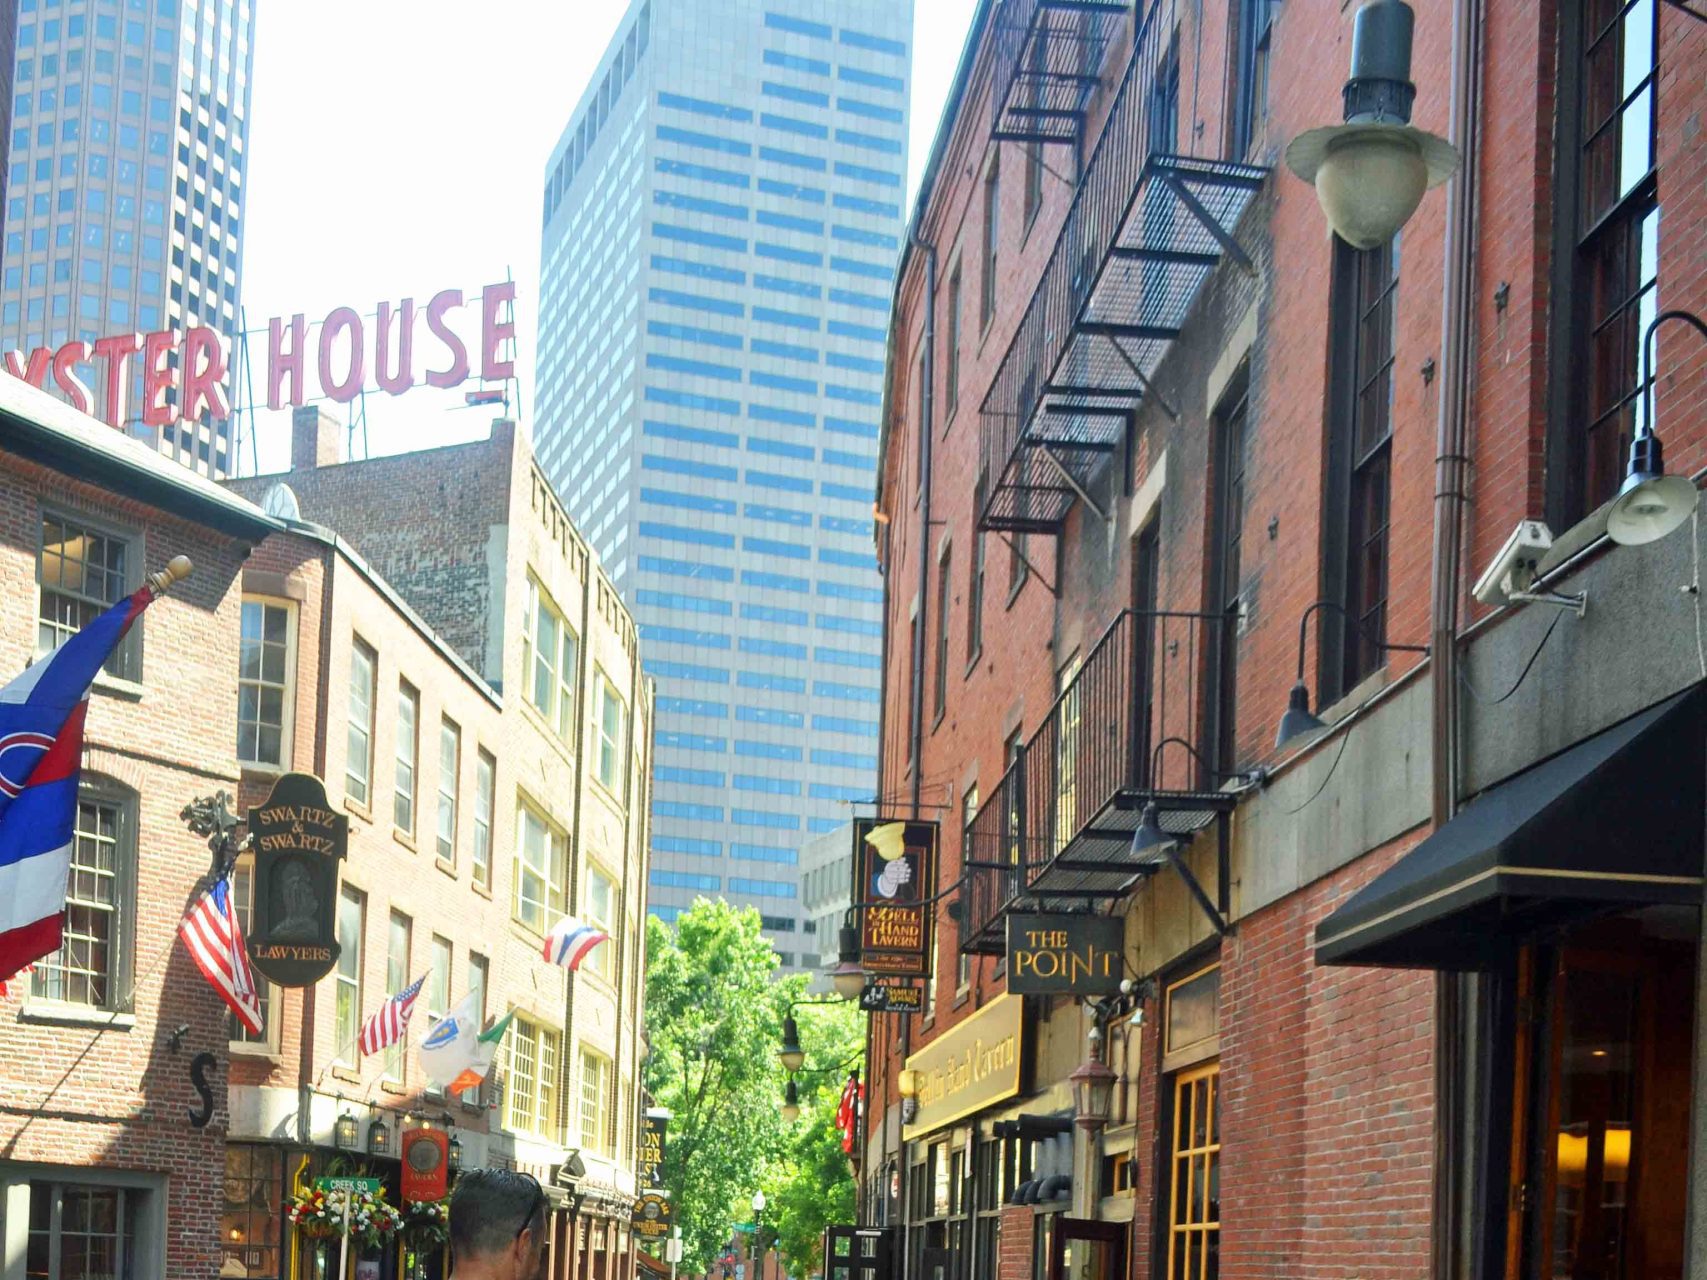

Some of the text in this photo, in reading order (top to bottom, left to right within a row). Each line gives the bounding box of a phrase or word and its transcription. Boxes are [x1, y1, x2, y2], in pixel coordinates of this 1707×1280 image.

[4, 281, 516, 427] YSTER HOUSE
[259, 806, 336, 829] SWARTZ
[291, 820, 304, 835] &
[260, 833, 335, 856] SWARTZ
[1026, 931, 1068, 947] THE
[255, 944, 332, 961] LAWYERS
[1014, 945, 1119, 984] POINT
[974, 1036, 1014, 1082] Tavern
[330, 1180, 355, 1191] CREEK
